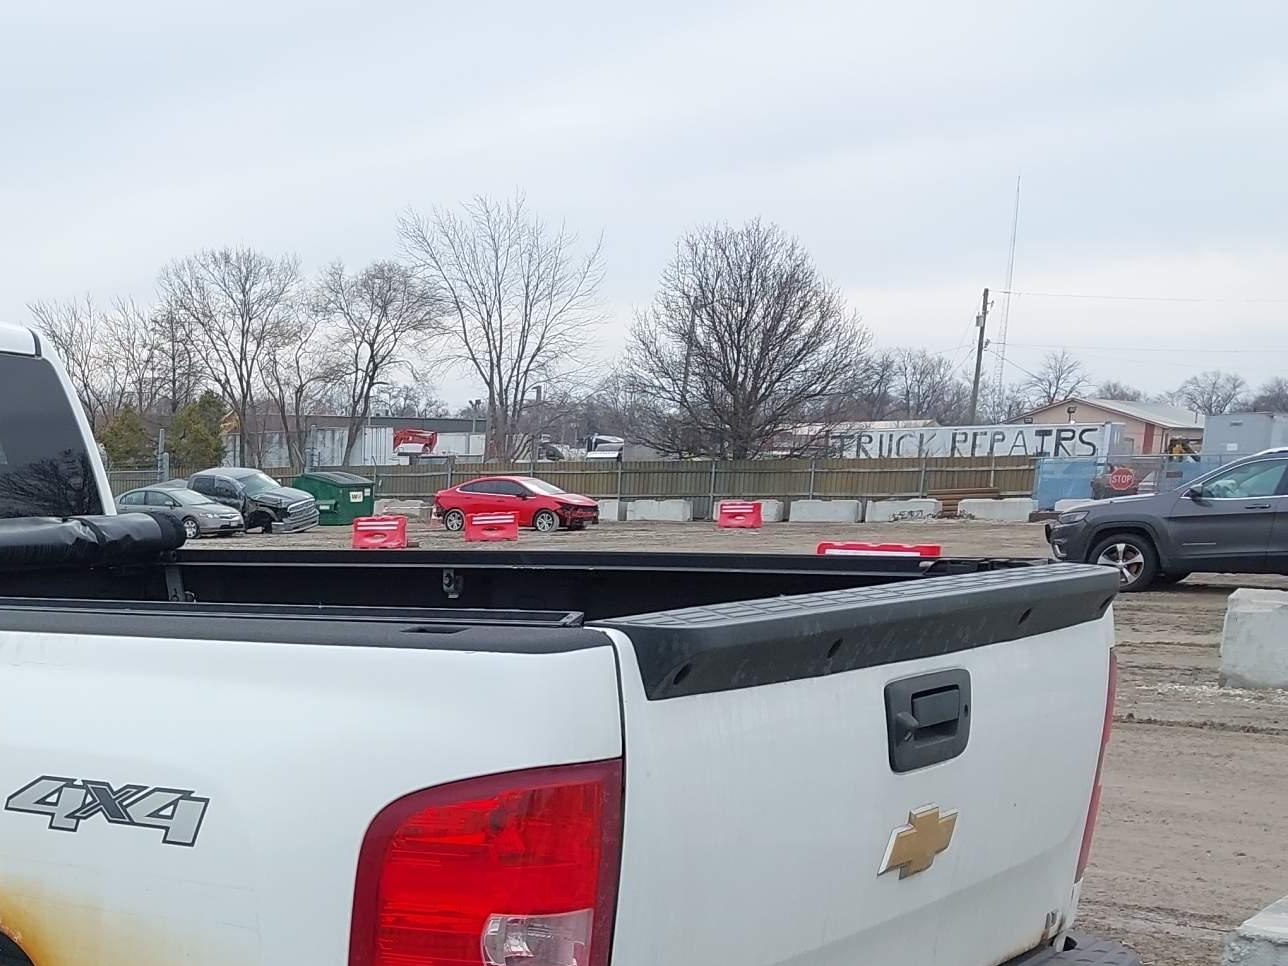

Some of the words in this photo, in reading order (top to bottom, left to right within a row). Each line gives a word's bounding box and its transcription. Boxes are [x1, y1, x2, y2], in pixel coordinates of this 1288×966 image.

[828, 433, 937, 458] TRUCK
[950, 428, 1098, 457] REPAIRS
[1112, 475, 1133, 483] STOP
